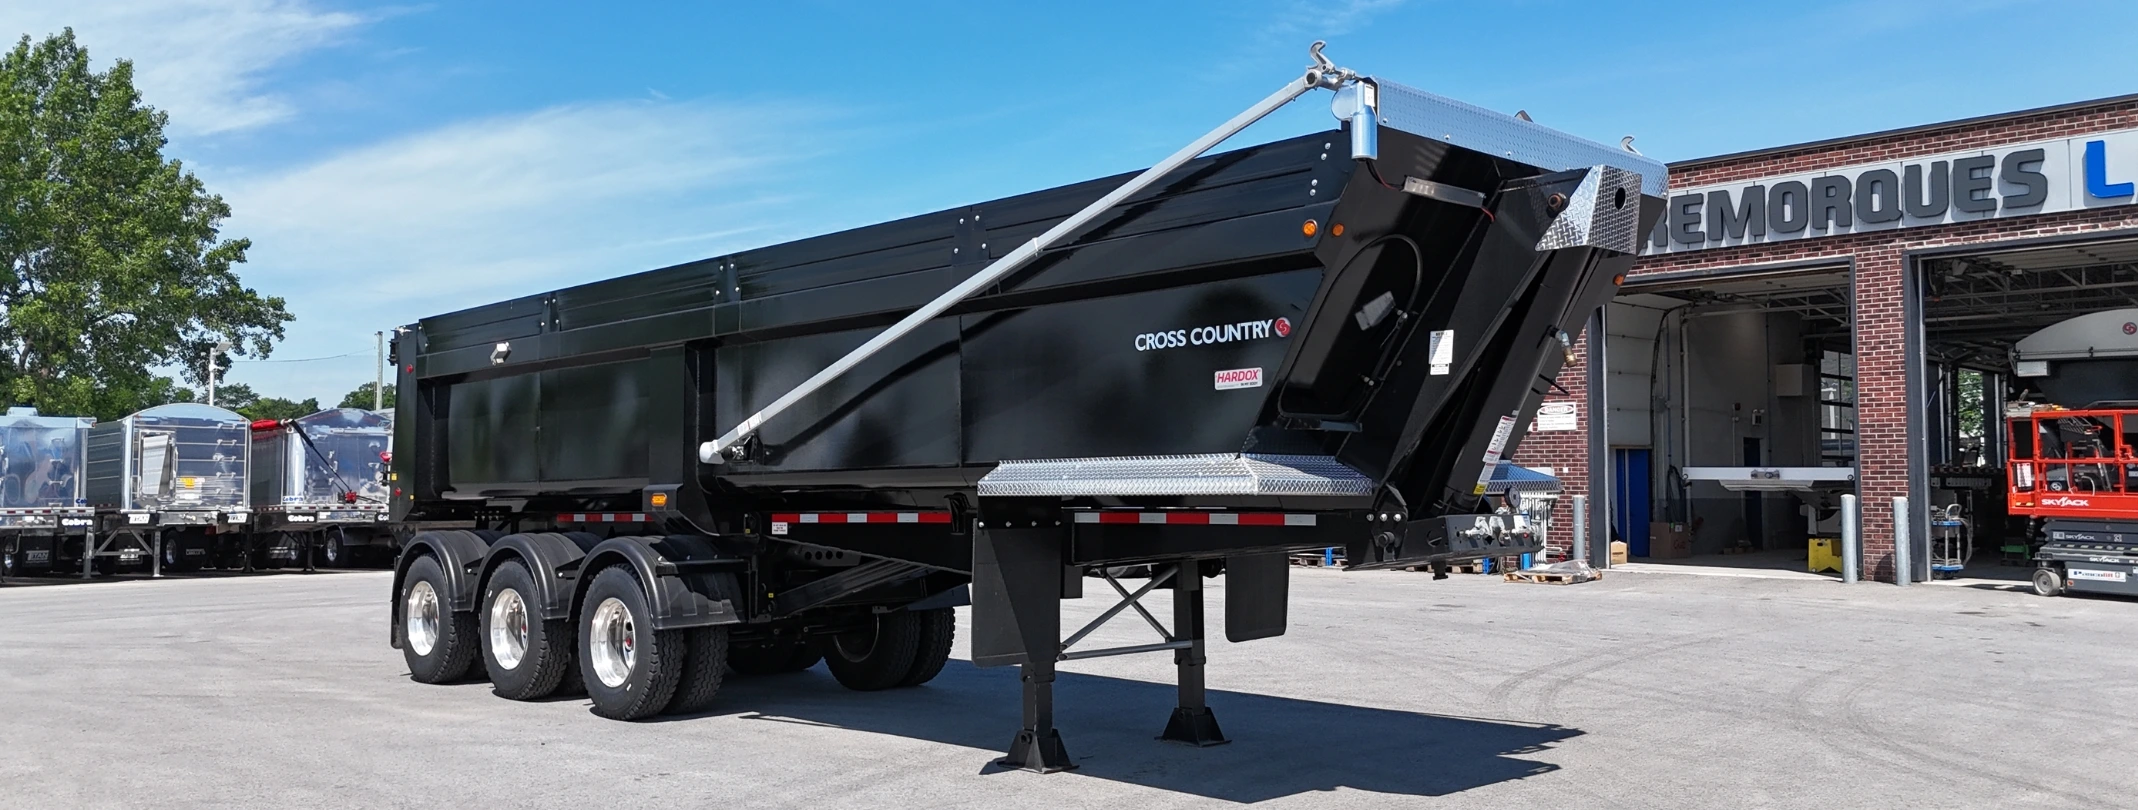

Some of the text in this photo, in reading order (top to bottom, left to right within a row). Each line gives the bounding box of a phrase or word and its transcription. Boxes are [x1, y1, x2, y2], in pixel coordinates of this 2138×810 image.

[2085, 140, 2135, 199] L
[1134, 318, 1274, 351] CROSS COUNTRY
[1216, 369, 1259, 383] HARDOX
[2041, 496, 2090, 507] SKYJACK
[61, 518, 93, 526] Cobra
[287, 514, 315, 522] Cobra
[2065, 533, 2095, 541] SKYJACK
[2088, 555, 2120, 563] SKYJACK
